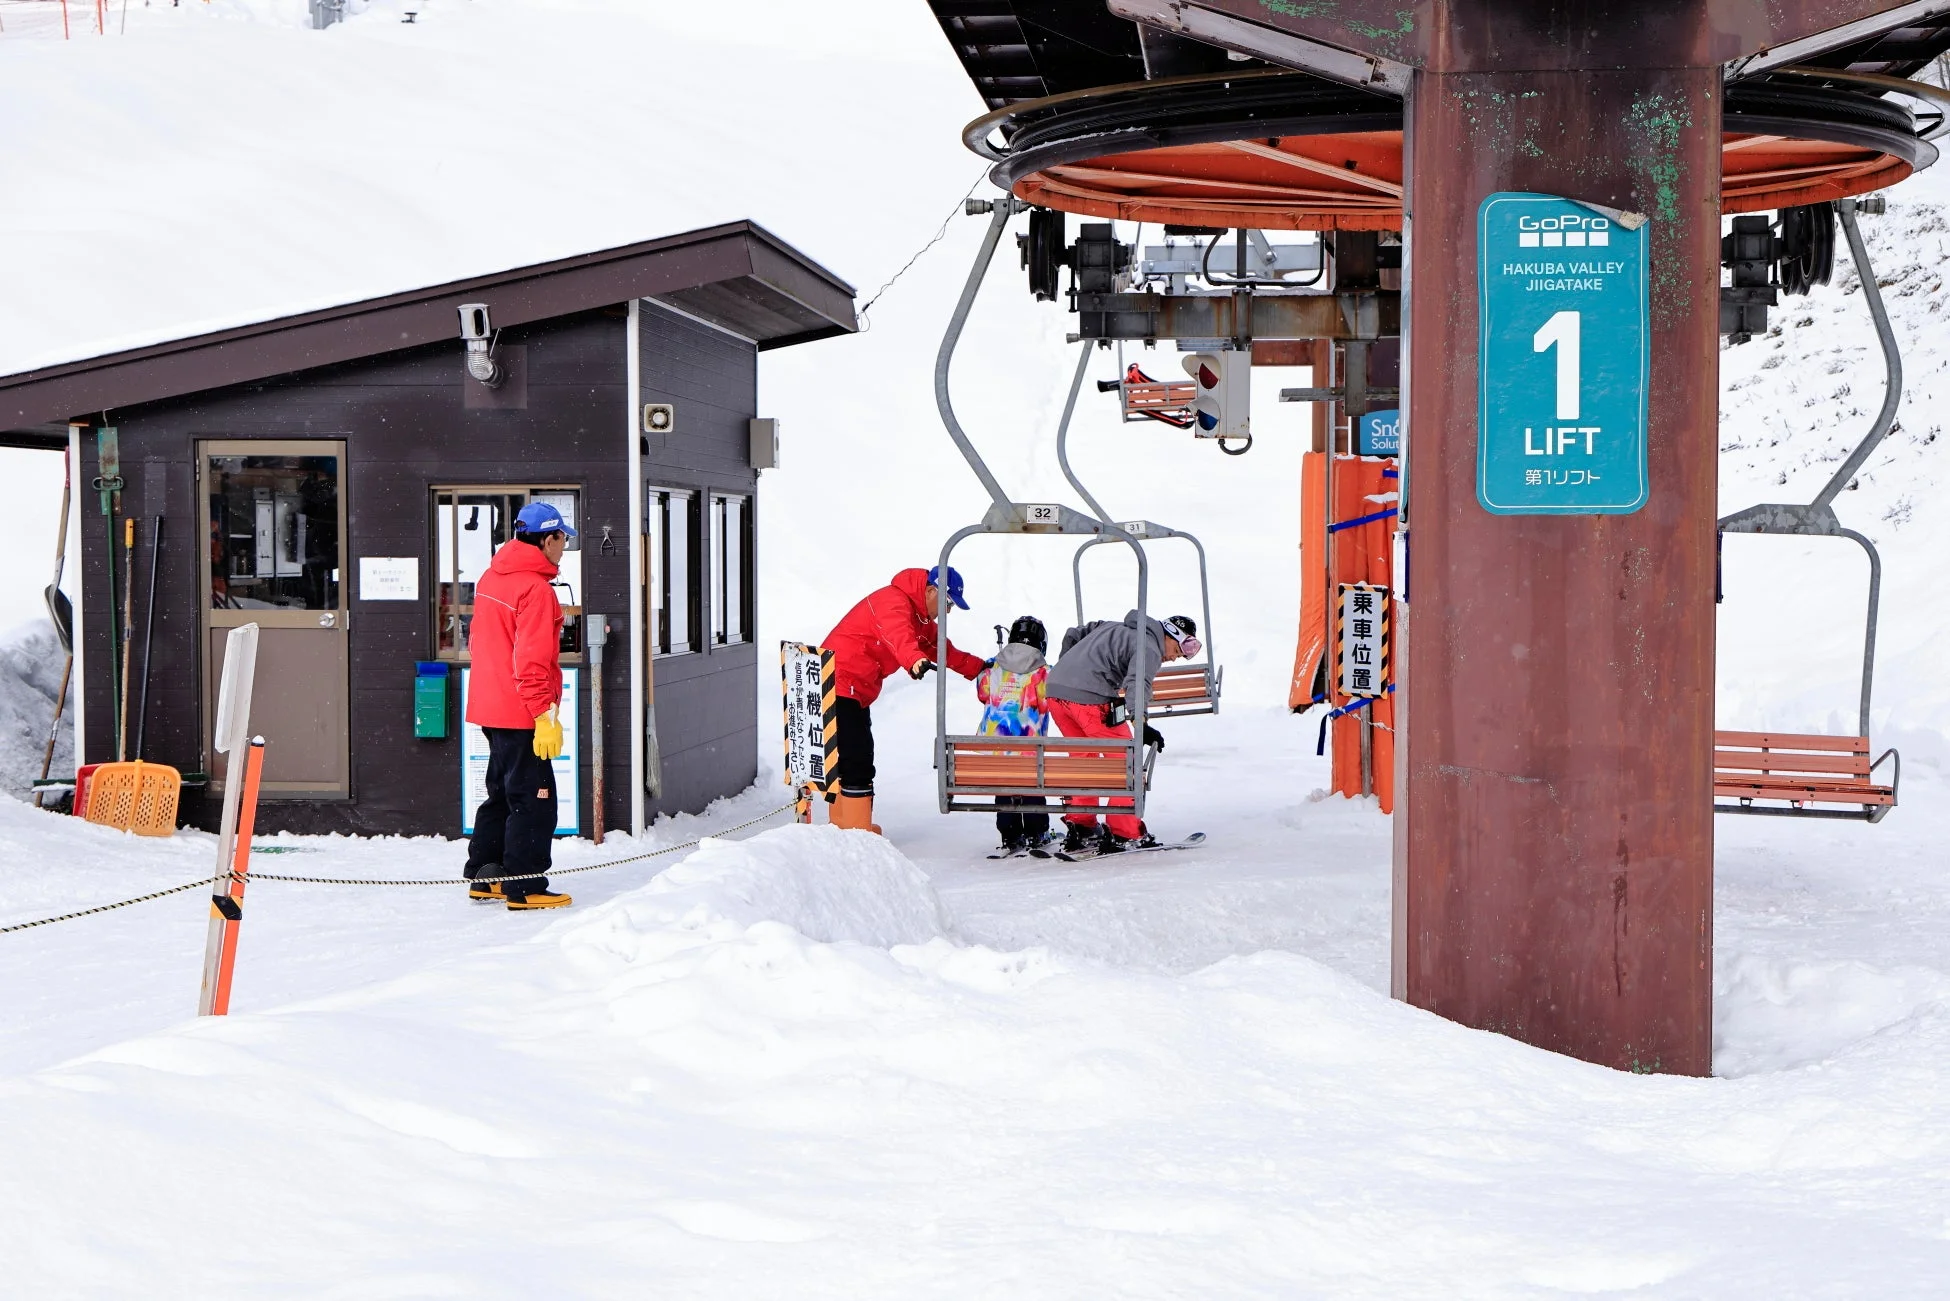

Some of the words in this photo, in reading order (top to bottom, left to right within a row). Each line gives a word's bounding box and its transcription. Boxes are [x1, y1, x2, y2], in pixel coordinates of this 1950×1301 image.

[1519, 214, 1609, 231] GoPro
[1503, 263, 1565, 275] HAKUBA
[1568, 262, 1625, 275] VALLEY
[1525, 278, 1602, 291] JIIGATAKE
[1533, 311, 1580, 420] 1
[1371, 437, 1400, 450] Solut
[1525, 428, 1601, 456] LIFT
[1525, 469, 1601, 486] 第1リフト
[1034, 507, 1051, 518] 32
[1129, 523, 1140, 531] 31
[1351, 592, 1374, 692] 乗車位置
[805, 658, 825, 782] 待機位置
